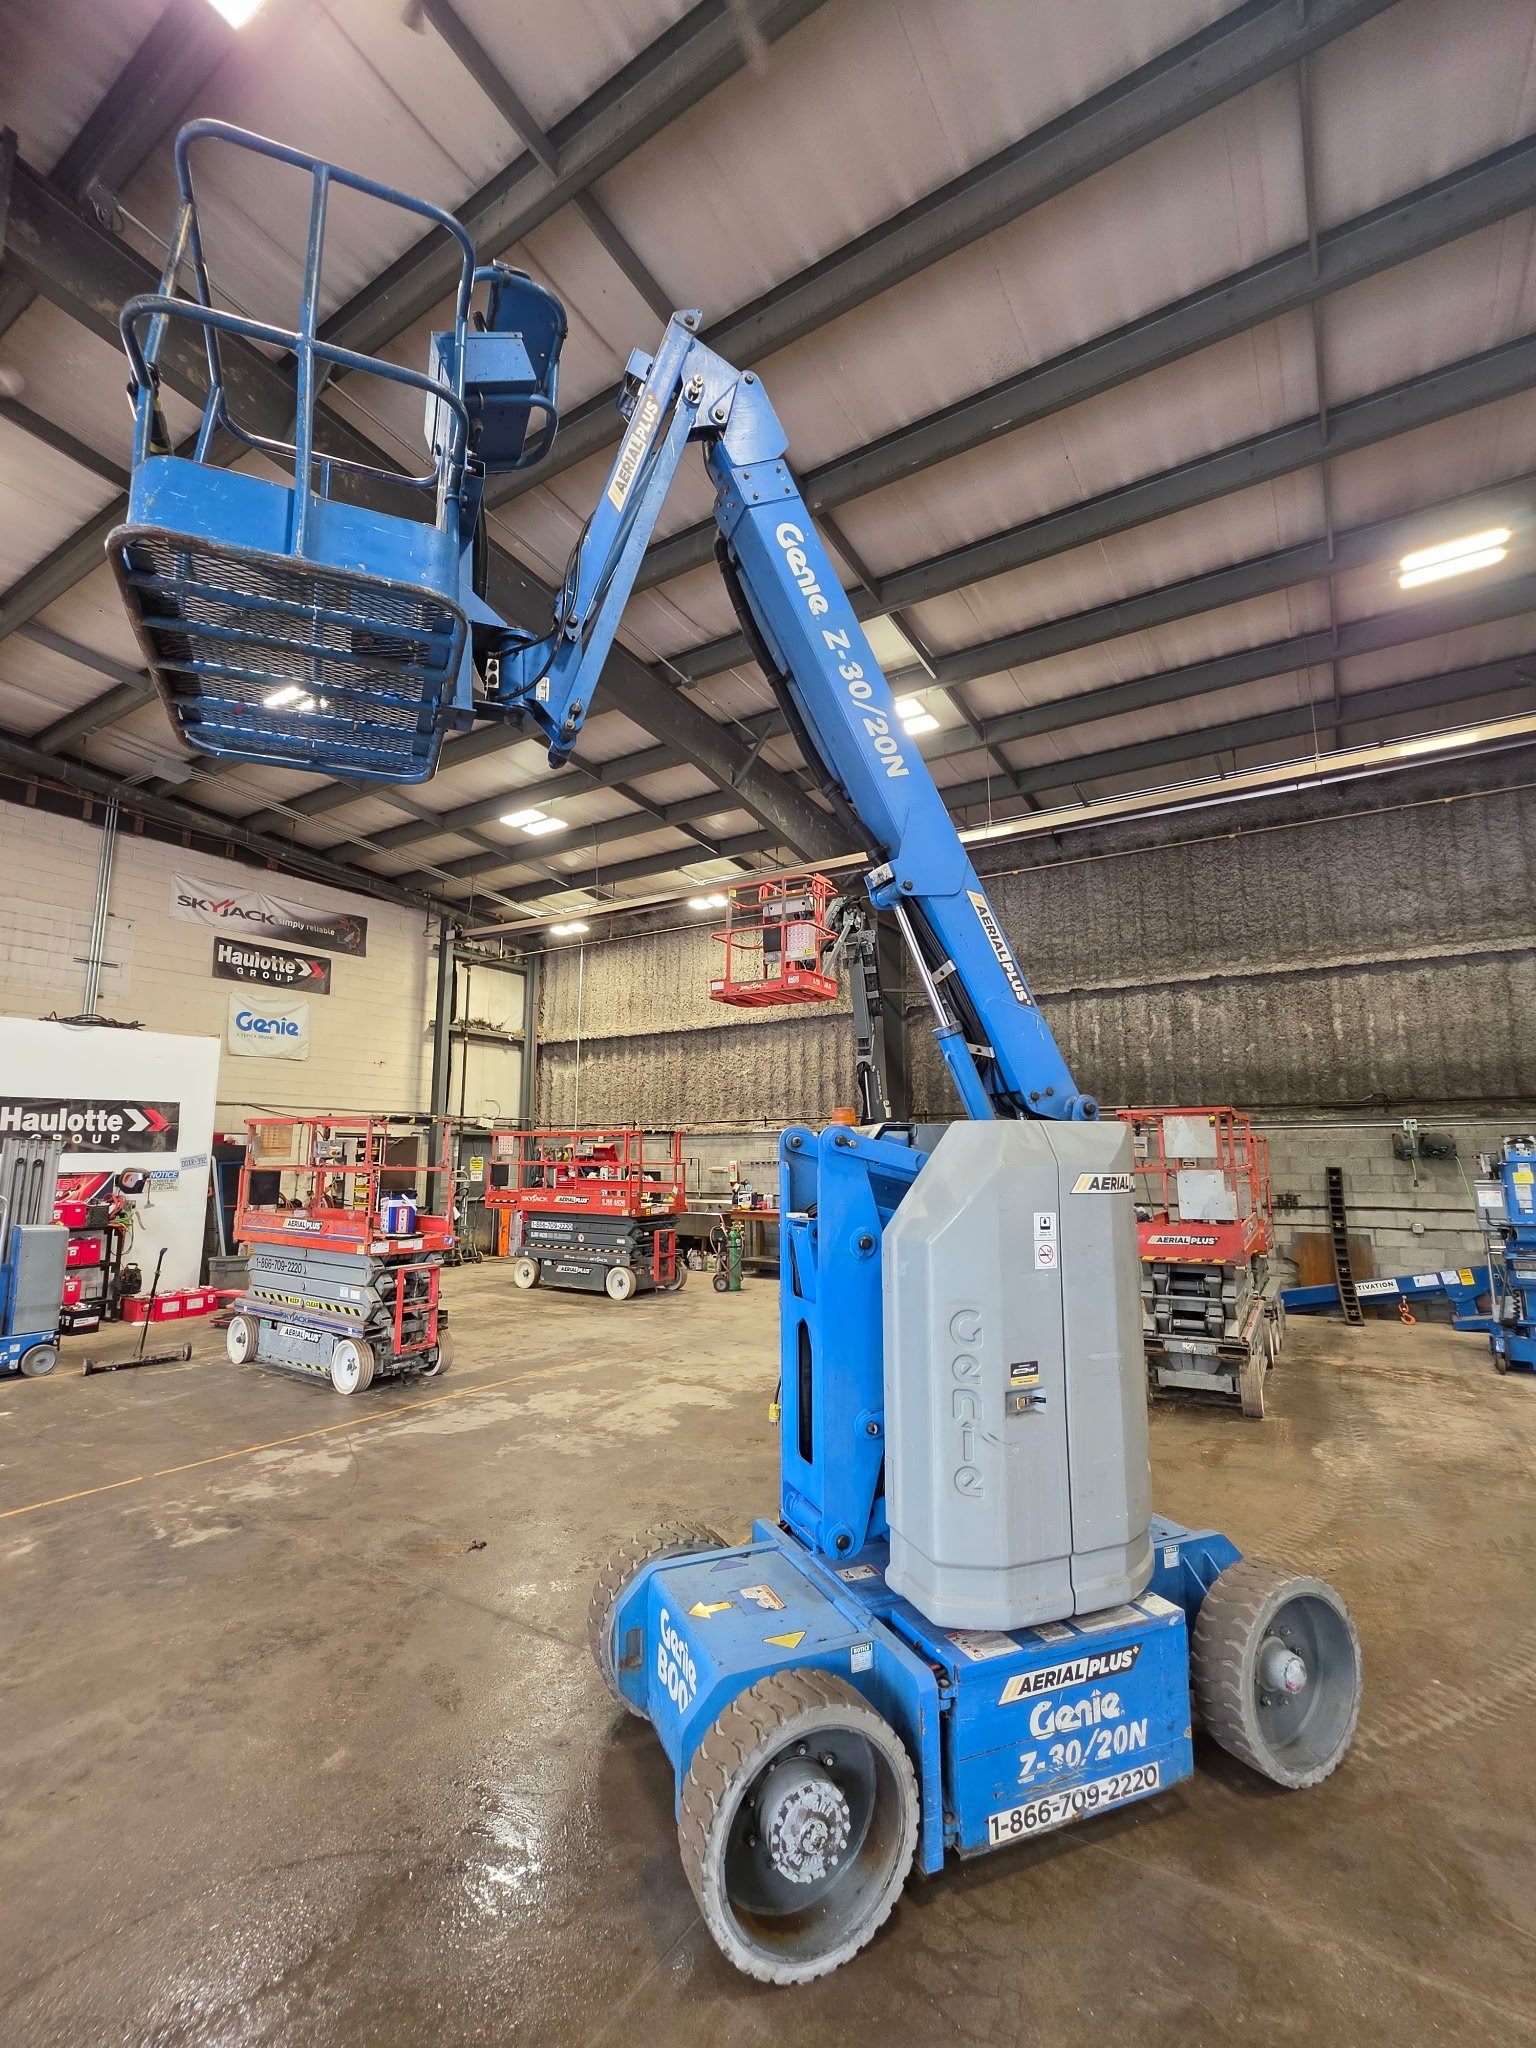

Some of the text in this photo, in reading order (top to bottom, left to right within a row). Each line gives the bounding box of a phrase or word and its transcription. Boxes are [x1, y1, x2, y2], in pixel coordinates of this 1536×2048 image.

[776, 522, 910, 778] Genie Z-30/20N
[177, 895, 335, 936] SKYJACK simply reliable
[218, 944, 296, 974] Haulotte
[236, 967, 294, 983] GROUP
[236, 1012, 299, 1036] Genie
[0, 1106, 123, 1132] Haulotte
[256, 1257, 303, 1274] 1-866-709-2220
[1357, 1281, 1394, 1291] TIVATION
[306, 1300, 319, 1308] CLEAR
[661, 1608, 697, 1696] Genie
[658, 1642, 693, 1715] BOO
[1029, 1688, 1120, 1740] Genie
[1018, 1718, 1148, 1785] Z-30/20N
[991, 1764, 1158, 1841] 1-866-709-2220
